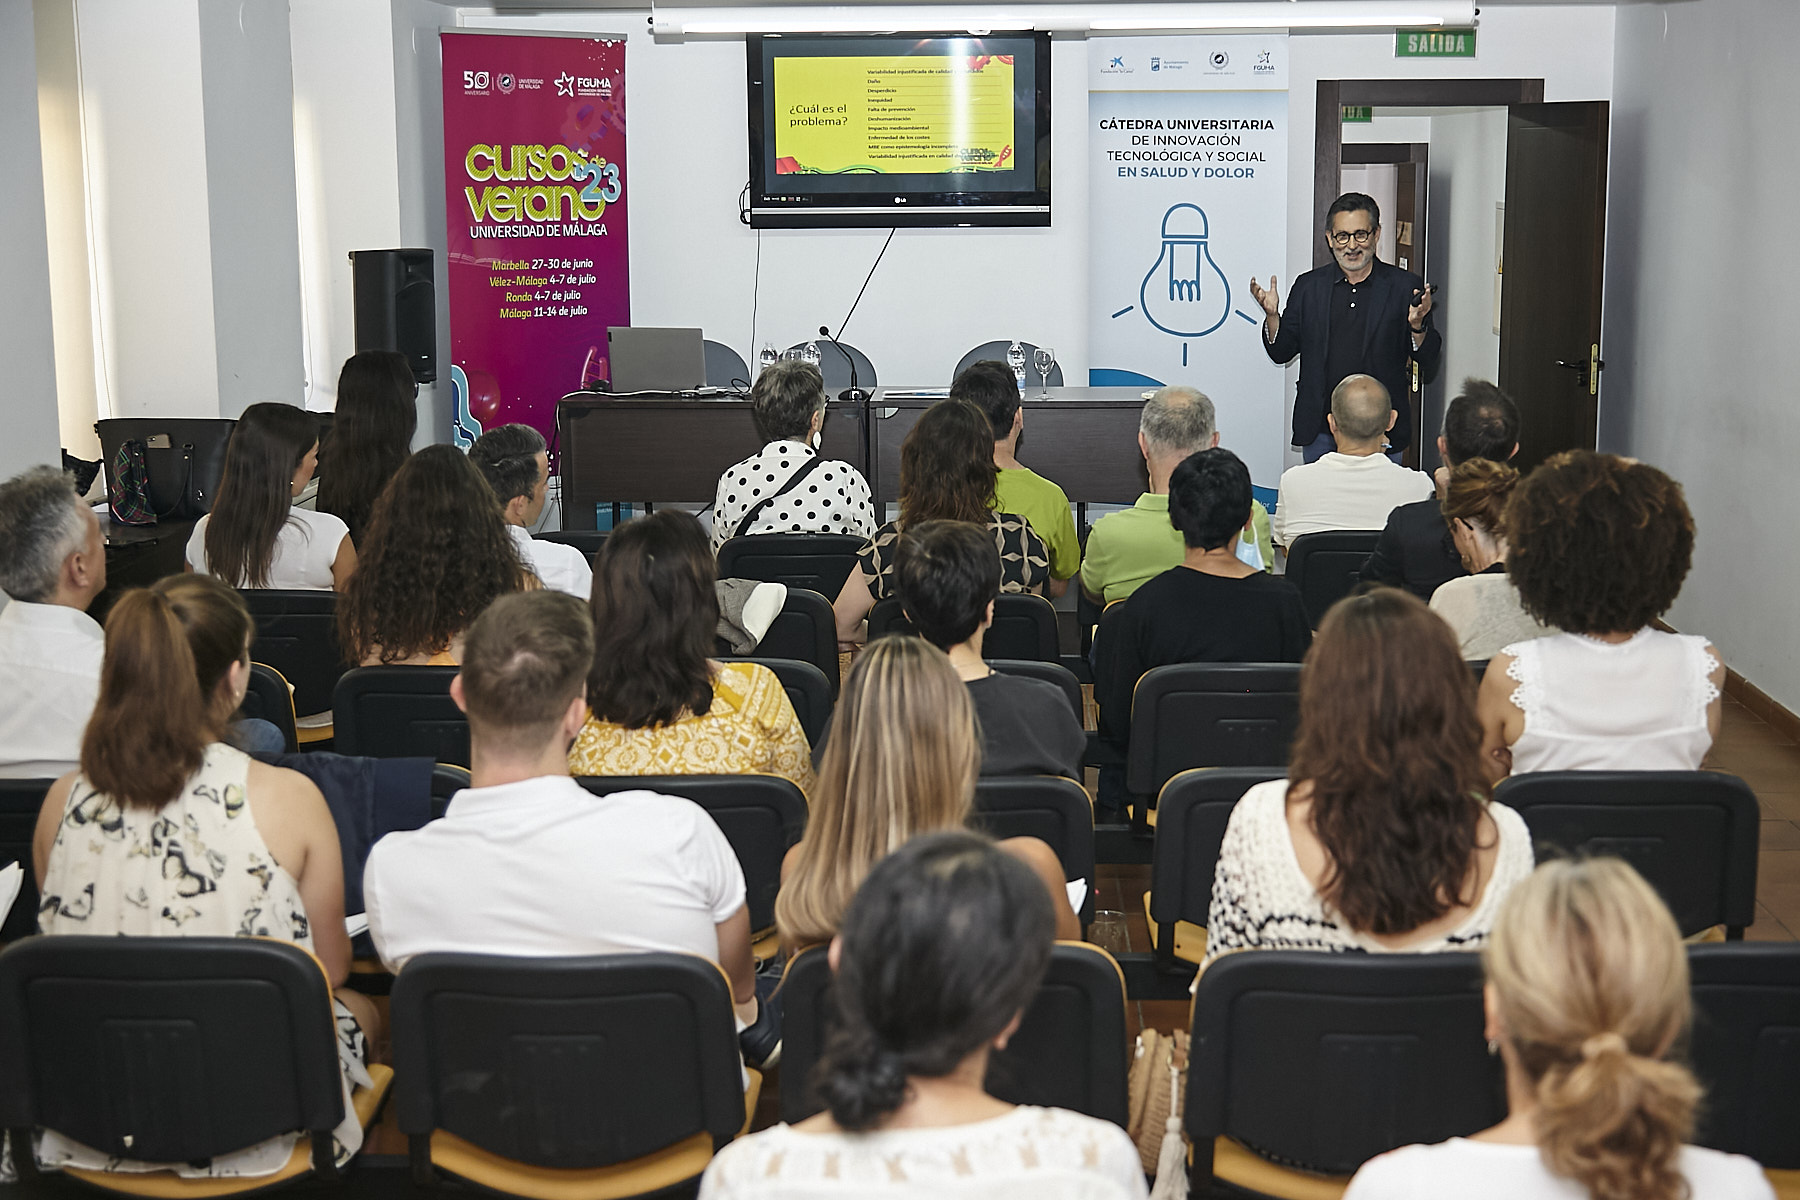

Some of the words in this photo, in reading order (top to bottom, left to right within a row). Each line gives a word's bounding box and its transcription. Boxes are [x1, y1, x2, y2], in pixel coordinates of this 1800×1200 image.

[1408, 33, 1465, 53] SALIDA
[463, 70, 489, 89] 50
[577, 77, 612, 88] FGUMA
[789, 103, 819, 115] ¿Cuál
[837, 103, 847, 113] el
[790, 116, 848, 128] problema?
[1100, 117, 1164, 130] CÁTEDRA
[1167, 119, 1275, 130] UNIVERSITARIA
[1131, 135, 1150, 146] DE
[1153, 133, 1241, 146] INNOVACIÓN
[590, 154, 607, 168] de
[1107, 148, 1202, 162] TECNOLÓGICA
[1205, 151, 1214, 162] Y
[1217, 151, 1266, 162] SOCIAL
[1117, 167, 1137, 177] EN
[1141, 167, 1188, 178] SALUD
[1191, 167, 1200, 178] Y
[1204, 167, 1255, 178] DOLOR
[464, 185, 606, 222] verano
[470, 225, 545, 239] UNIVERSIDAD
[546, 225, 561, 238] DE
[562, 221, 608, 237] MÁLAGA
[492, 259, 529, 271] Marbella
[531, 258, 560, 270] 27-30
[561, 258, 571, 269] de
[572, 258, 593, 271] junio
[489, 275, 548, 288] Vélez-Málaga
[549, 274, 566, 285] 4-7
[566, 274, 577, 285] de
[577, 273, 597, 286] julio
[506, 291, 533, 303] Ronda
[534, 290, 551, 301] 4-7
[551, 290, 562, 301] de
[562, 289, 581, 302] julio
[499, 307, 532, 320] Málaga
[533, 306, 557, 317] 11-14
[558, 306, 569, 316] de
[569, 305, 588, 318] julio
